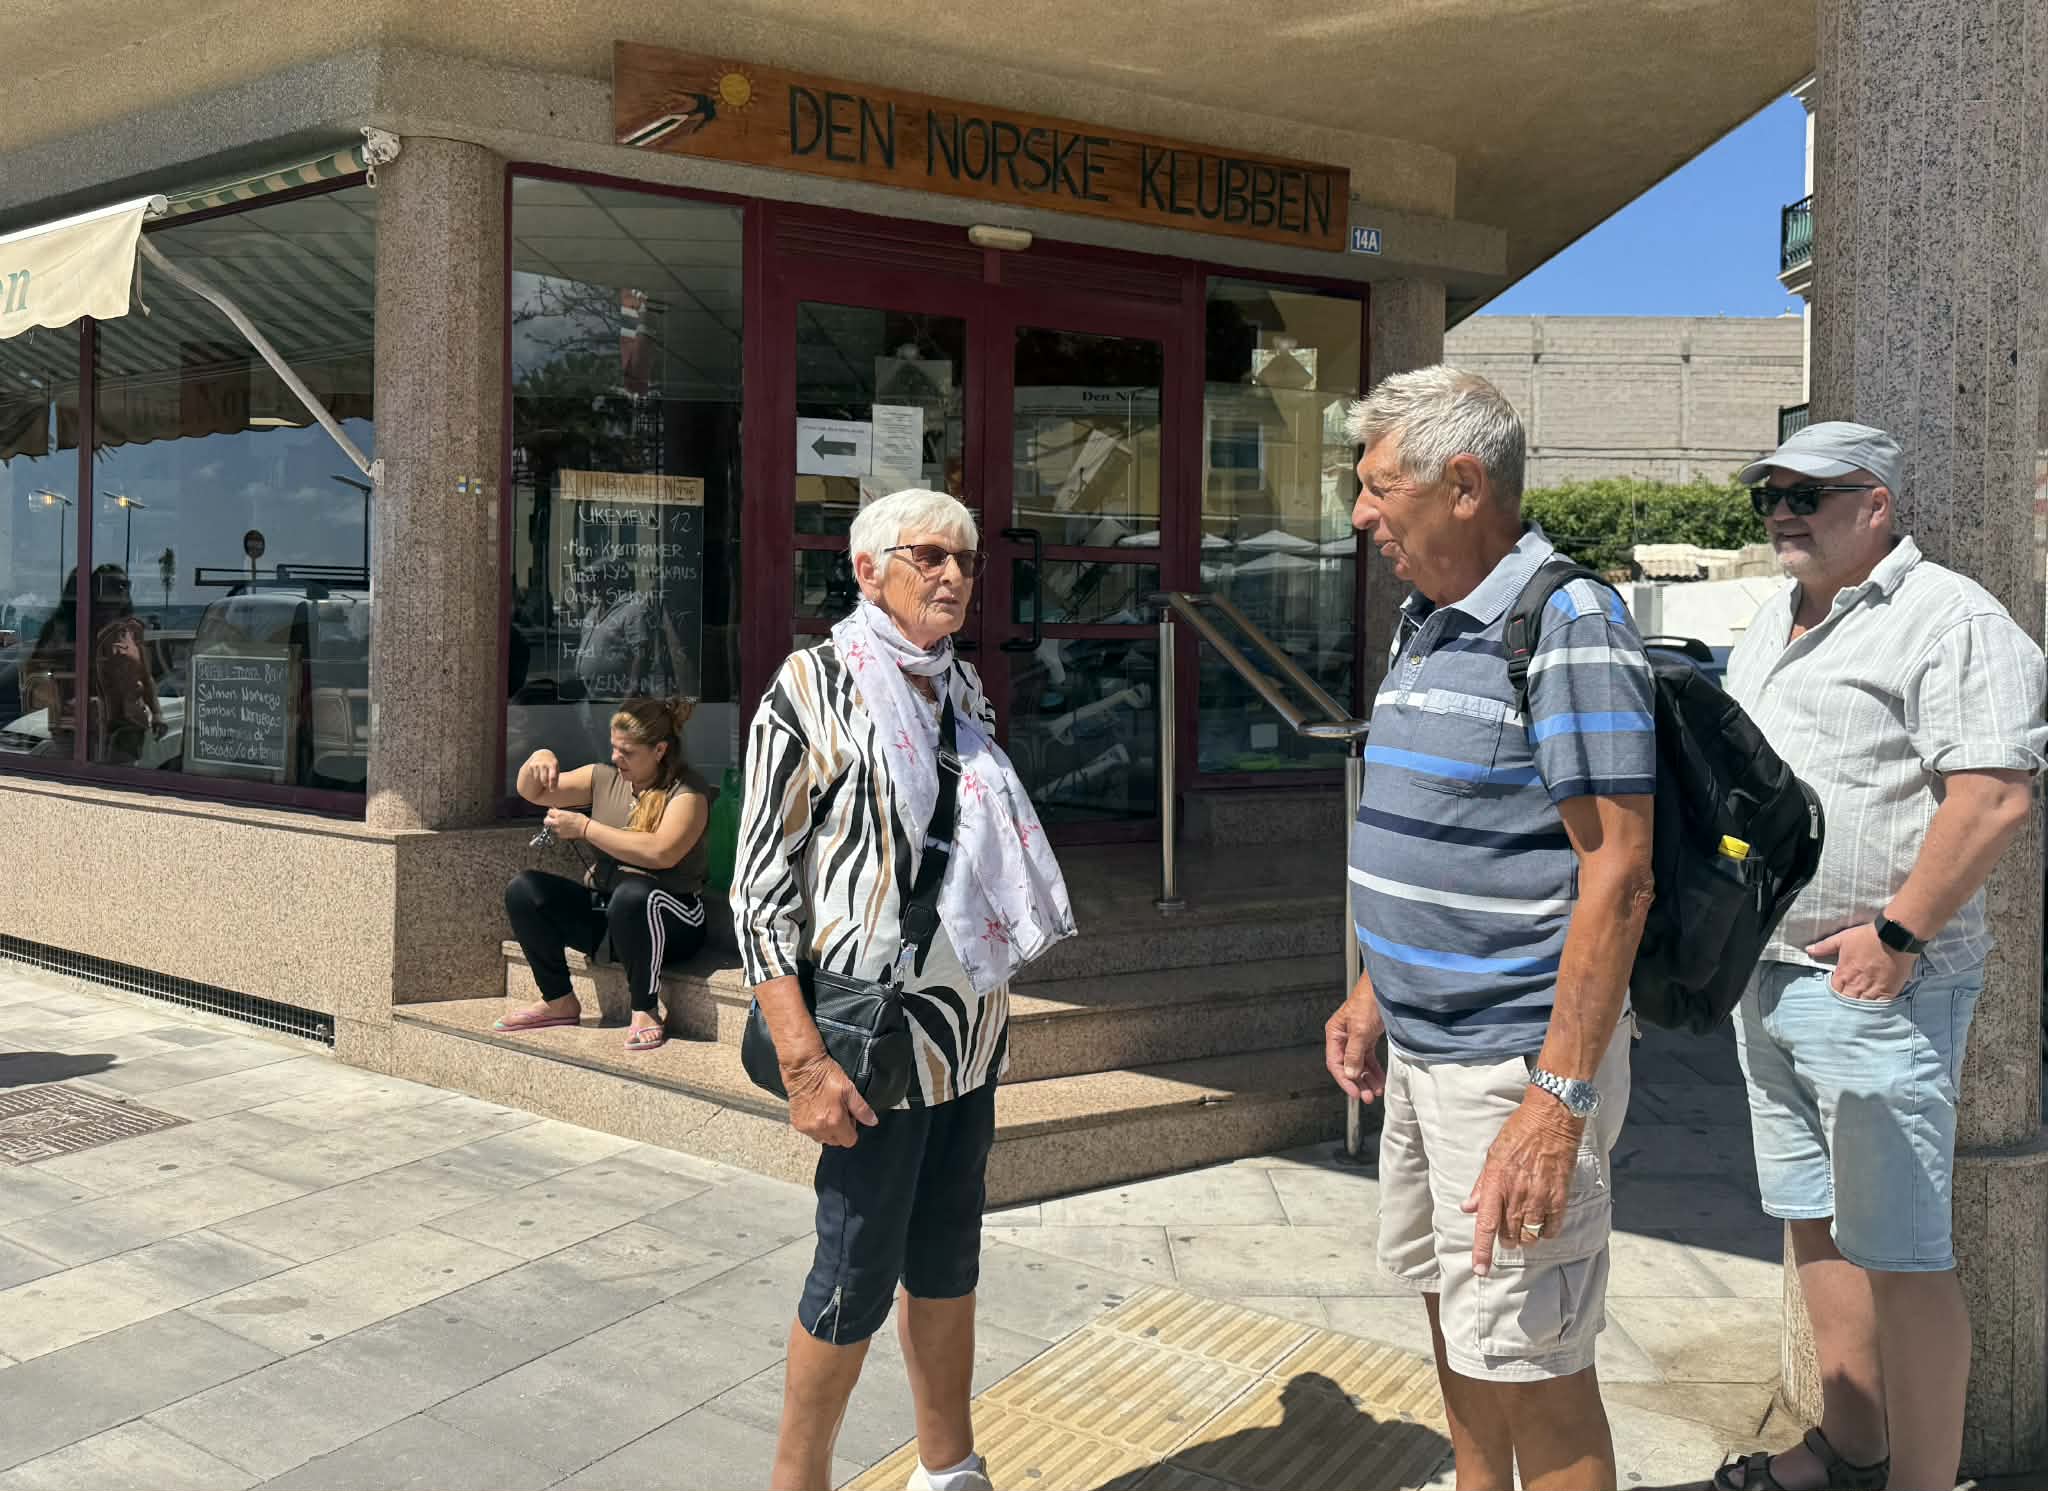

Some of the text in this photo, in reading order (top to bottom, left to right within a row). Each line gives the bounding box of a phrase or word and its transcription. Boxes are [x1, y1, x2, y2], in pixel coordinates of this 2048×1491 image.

[790, 86, 1332, 237] DEN NORSKE KLUBBEN
[1354, 230, 1378, 251] 14A
[0, 268, 31, 315] n
[1082, 391, 1110, 402] Den
[670, 511, 692, 533] 12
